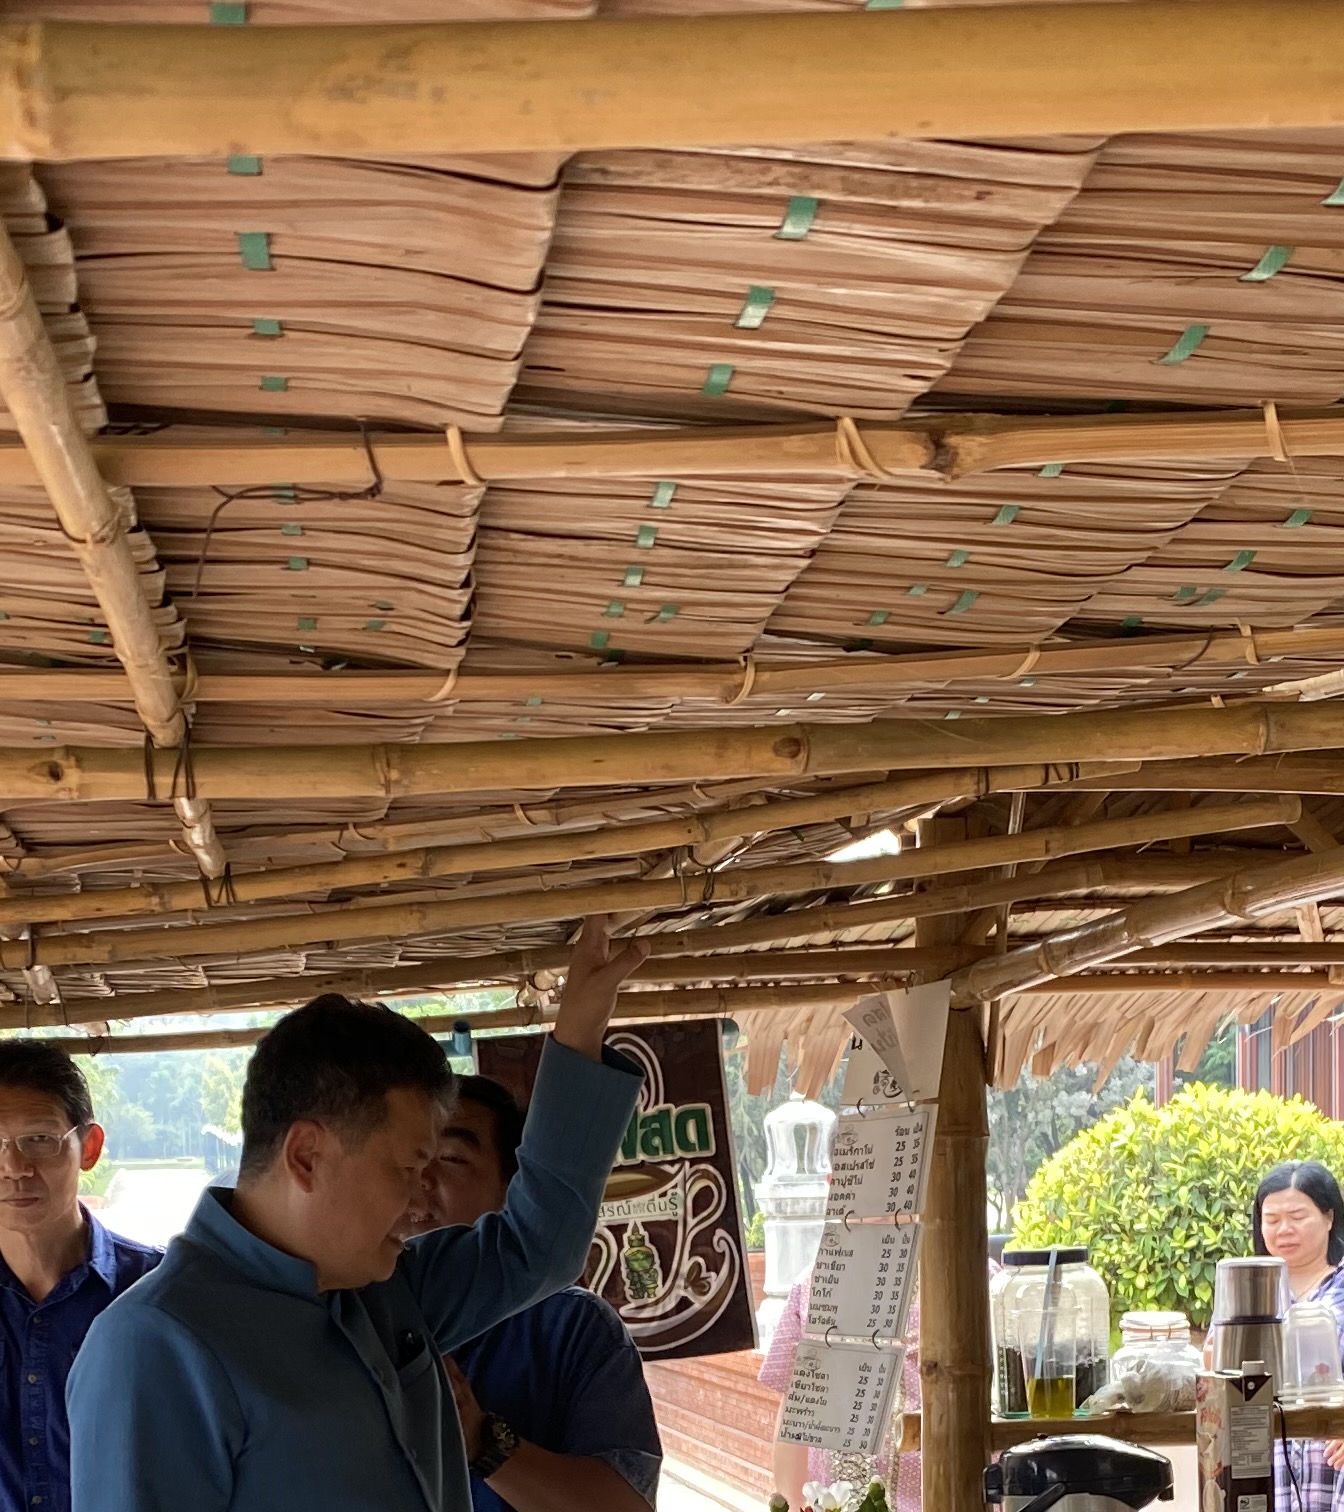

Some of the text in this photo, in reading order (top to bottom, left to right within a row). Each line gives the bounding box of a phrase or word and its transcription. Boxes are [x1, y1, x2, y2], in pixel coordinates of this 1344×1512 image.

[896, 1141, 906, 1151] 25
[894, 1156, 904, 1167] 25
[891, 1172, 901, 1182] 30
[908, 1169, 916, 1179] 40
[888, 1187, 898, 1197] 30
[907, 1184, 914, 1195] 40
[885, 1202, 896, 1212] 30
[903, 1200, 912, 1210] 40
[881, 1249, 891, 1258] 25
[899, 1249, 908, 1258] 30
[878, 1263, 889, 1273] 30
[896, 1263, 905, 1273] 35
[876, 1277, 886, 1287] 30
[893, 1277, 902, 1287] 35
[873, 1291, 883, 1301] 30
[890, 1291, 899, 1301] 35
[870, 1304, 880, 1314] 30
[887, 1305, 896, 1315] 35
[867, 1318, 877, 1328] 25
[883, 1318, 893, 1328] 30
[858, 1376, 869, 1385] 25
[876, 1377, 884, 1386] 30
[855, 1388, 866, 1397] 25
[853, 1401, 863, 1410] 25
[870, 1403, 878, 1412] 30
[850, 1414, 859, 1423] 25
[867, 1415, 874, 1424] 30
[847, 1427, 855, 1435] 25
[862, 1428, 870, 1437] 30
[843, 1439, 852, 1447] 25
[859, 1441, 867, 1449] 30
